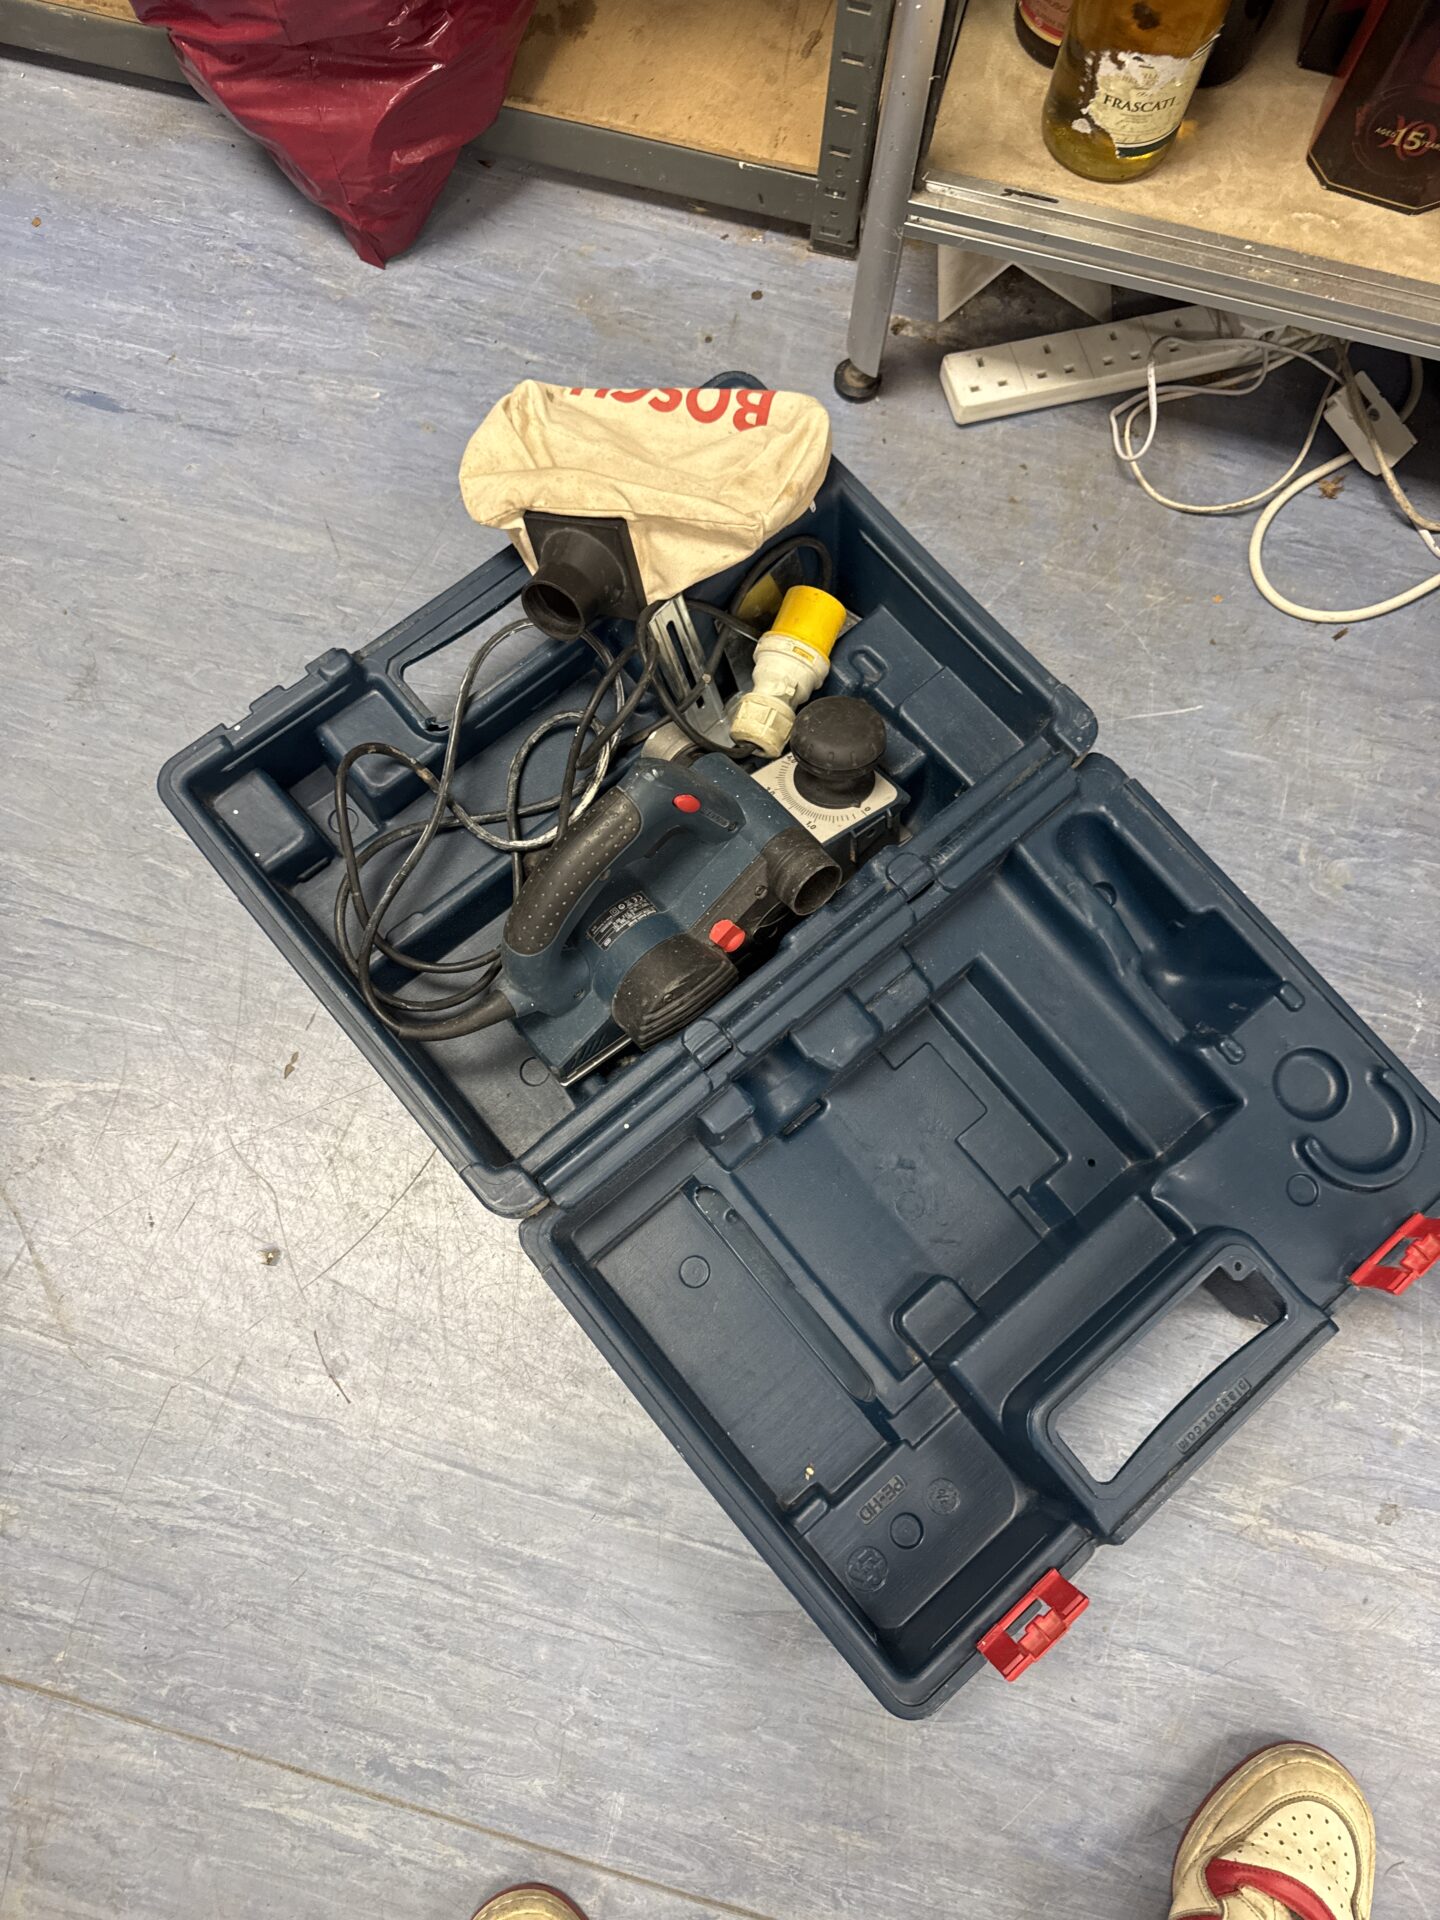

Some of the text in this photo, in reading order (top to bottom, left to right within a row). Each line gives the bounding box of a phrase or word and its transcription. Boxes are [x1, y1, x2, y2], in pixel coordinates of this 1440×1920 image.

[1103, 95, 1176, 112] FRASCATI
[1392, 127, 1425, 151] 15
[571, 387, 776, 432] BOS
[806, 820, 817, 830] 1,0
[859, 1476, 905, 1522] PE-HD
